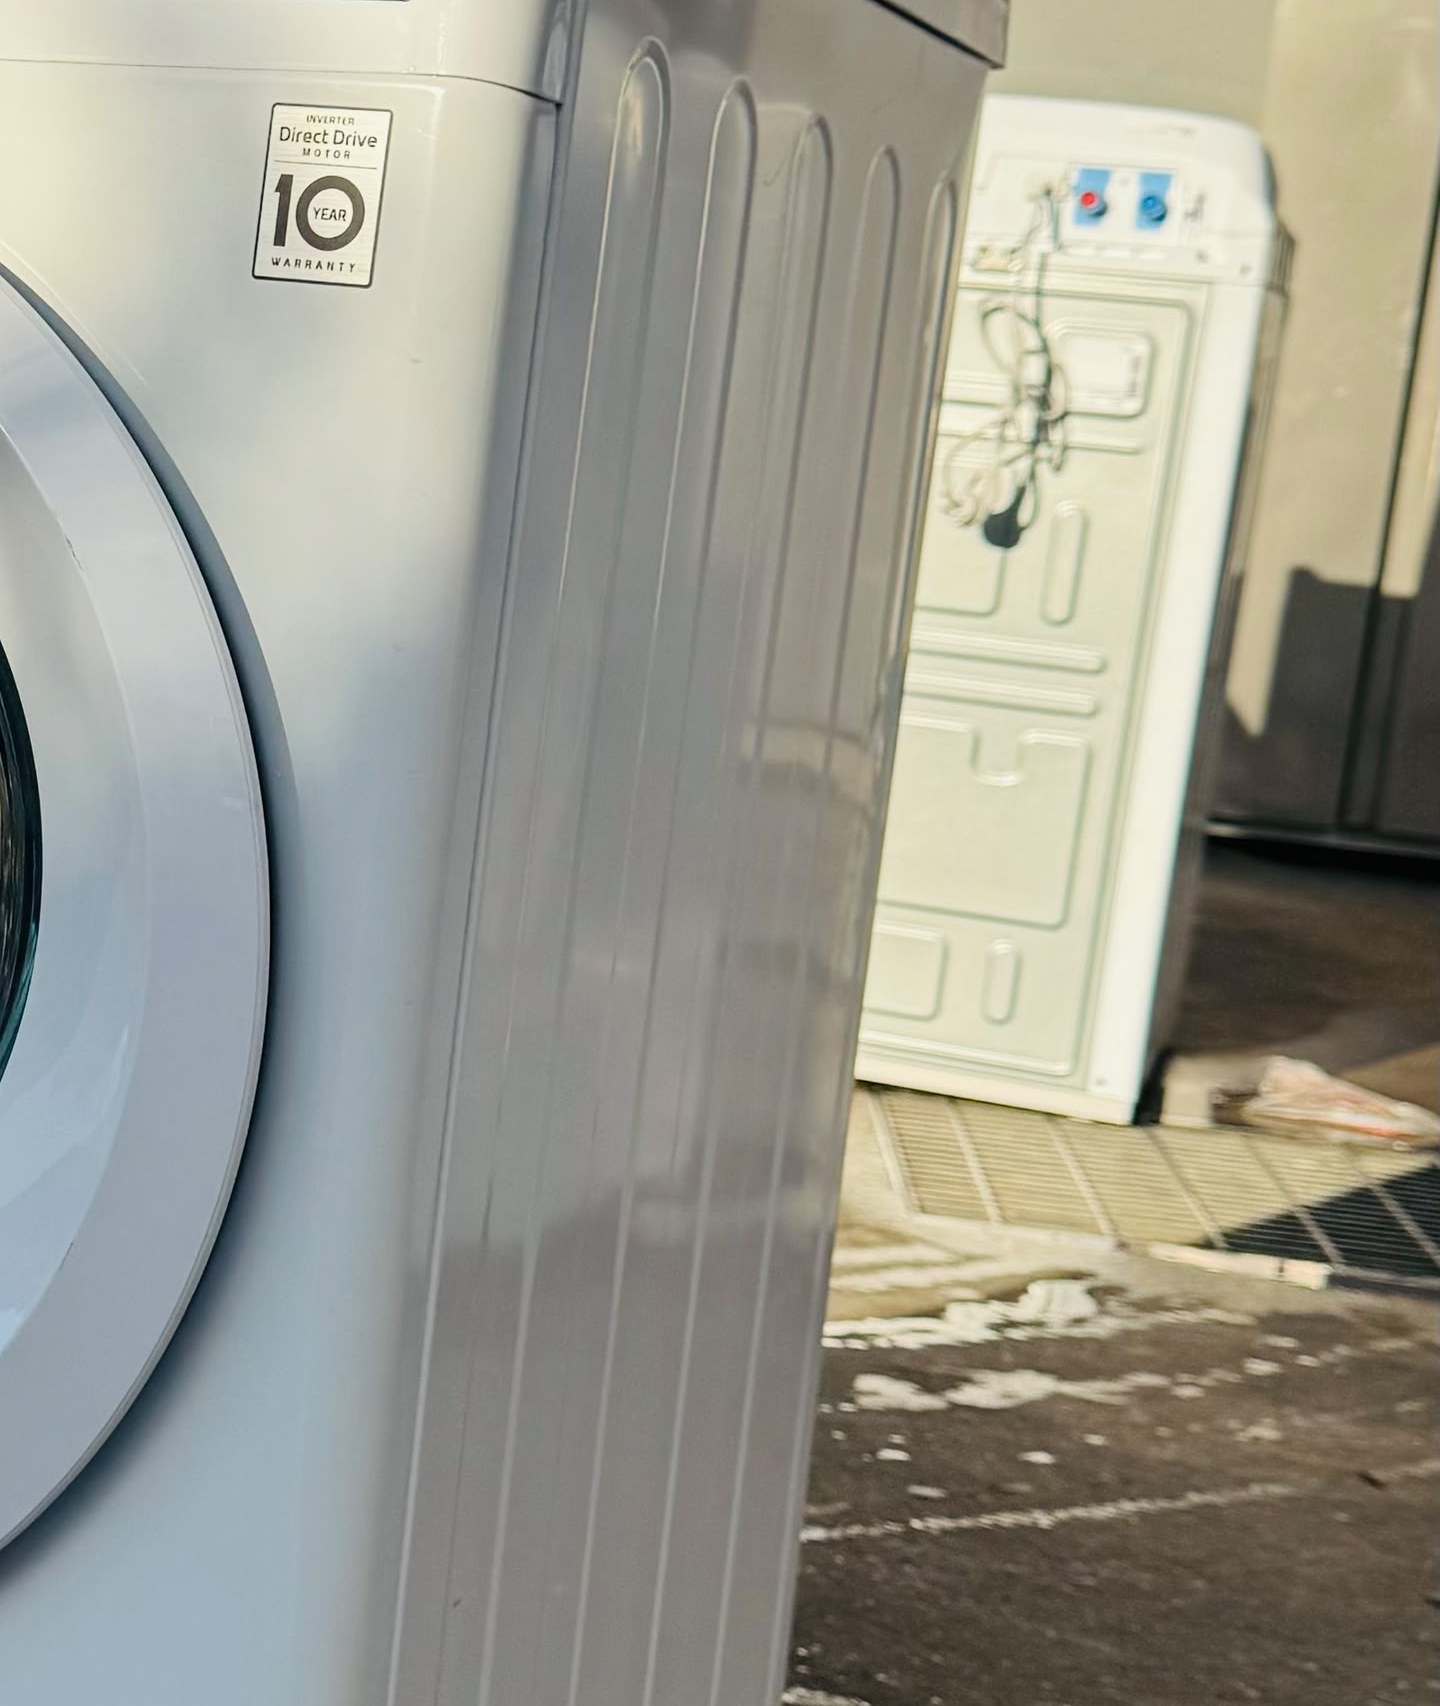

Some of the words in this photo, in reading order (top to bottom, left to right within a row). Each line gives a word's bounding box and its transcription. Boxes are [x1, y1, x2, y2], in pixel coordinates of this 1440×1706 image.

[305, 114, 356, 126] INVERTER
[279, 126, 330, 145] Direct
[332, 129, 378, 148] Drive
[302, 147, 351, 160] MOTOR
[273, 173, 366, 252] 10
[313, 206, 348, 222] YEAR
[271, 256, 357, 273] WARRANTY
